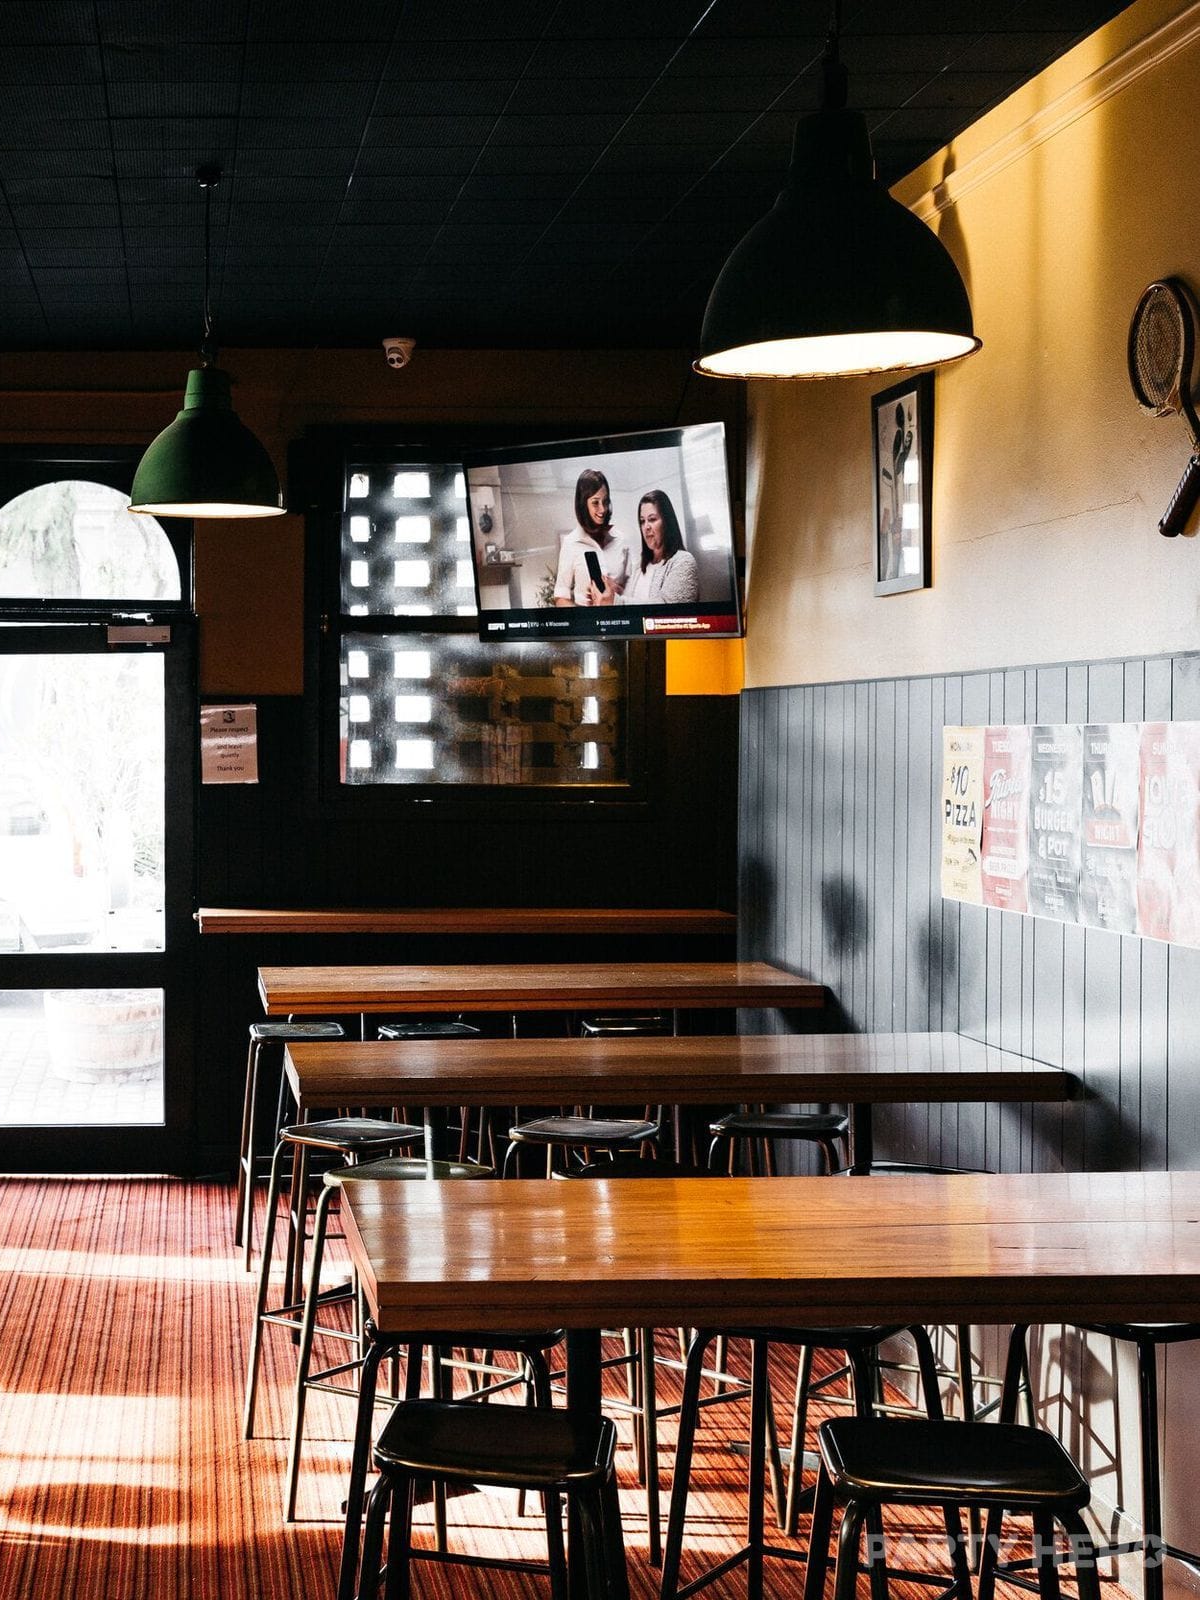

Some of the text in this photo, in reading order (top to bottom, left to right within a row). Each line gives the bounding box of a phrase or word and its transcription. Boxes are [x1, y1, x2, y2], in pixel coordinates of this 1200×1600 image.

[951, 765, 970, 797] $10
[1038, 770, 1067, 804] $15
[945, 799, 977, 828] PIZZA
[1034, 807, 1075, 833] BURGER
[1047, 837, 1069, 857] POT
